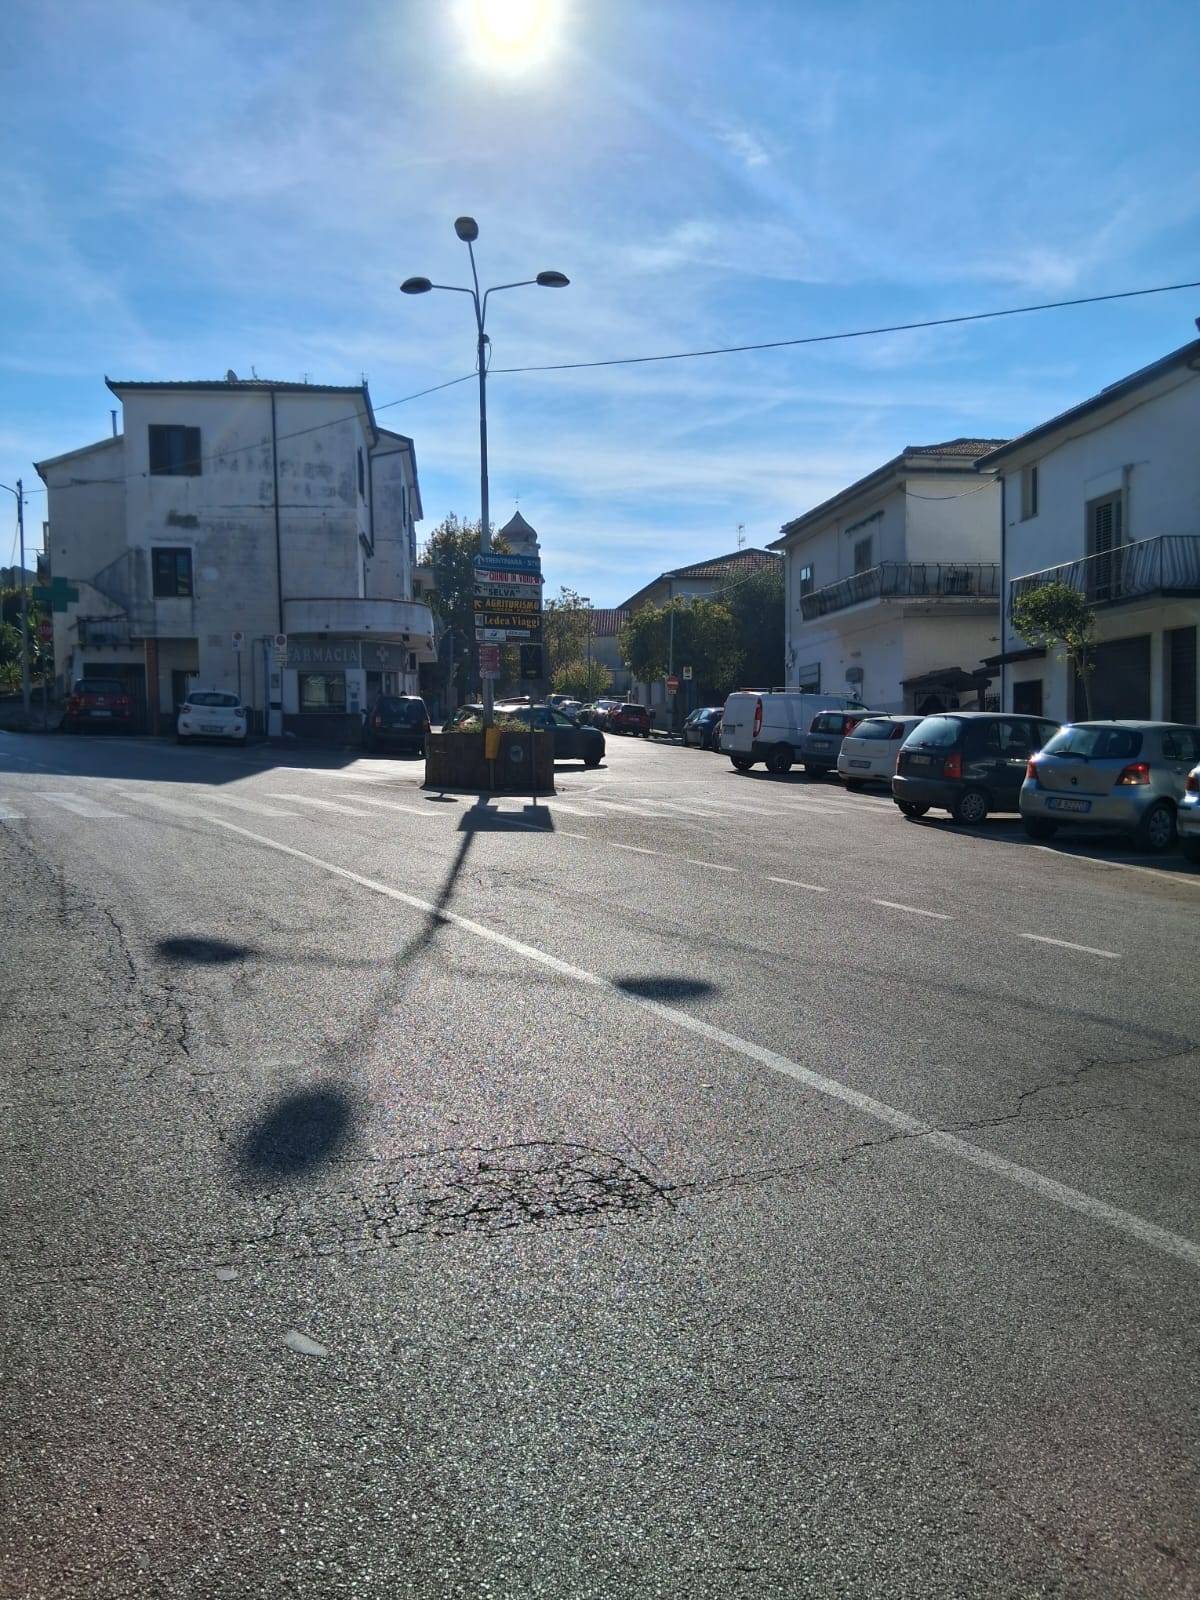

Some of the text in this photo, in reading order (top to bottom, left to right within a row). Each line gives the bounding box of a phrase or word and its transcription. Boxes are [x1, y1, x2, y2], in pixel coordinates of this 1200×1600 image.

[486, 599, 539, 610] AGRITURISMO
[512, 616, 540, 629] Viaggi
[287, 647, 358, 662] FARMACIA
